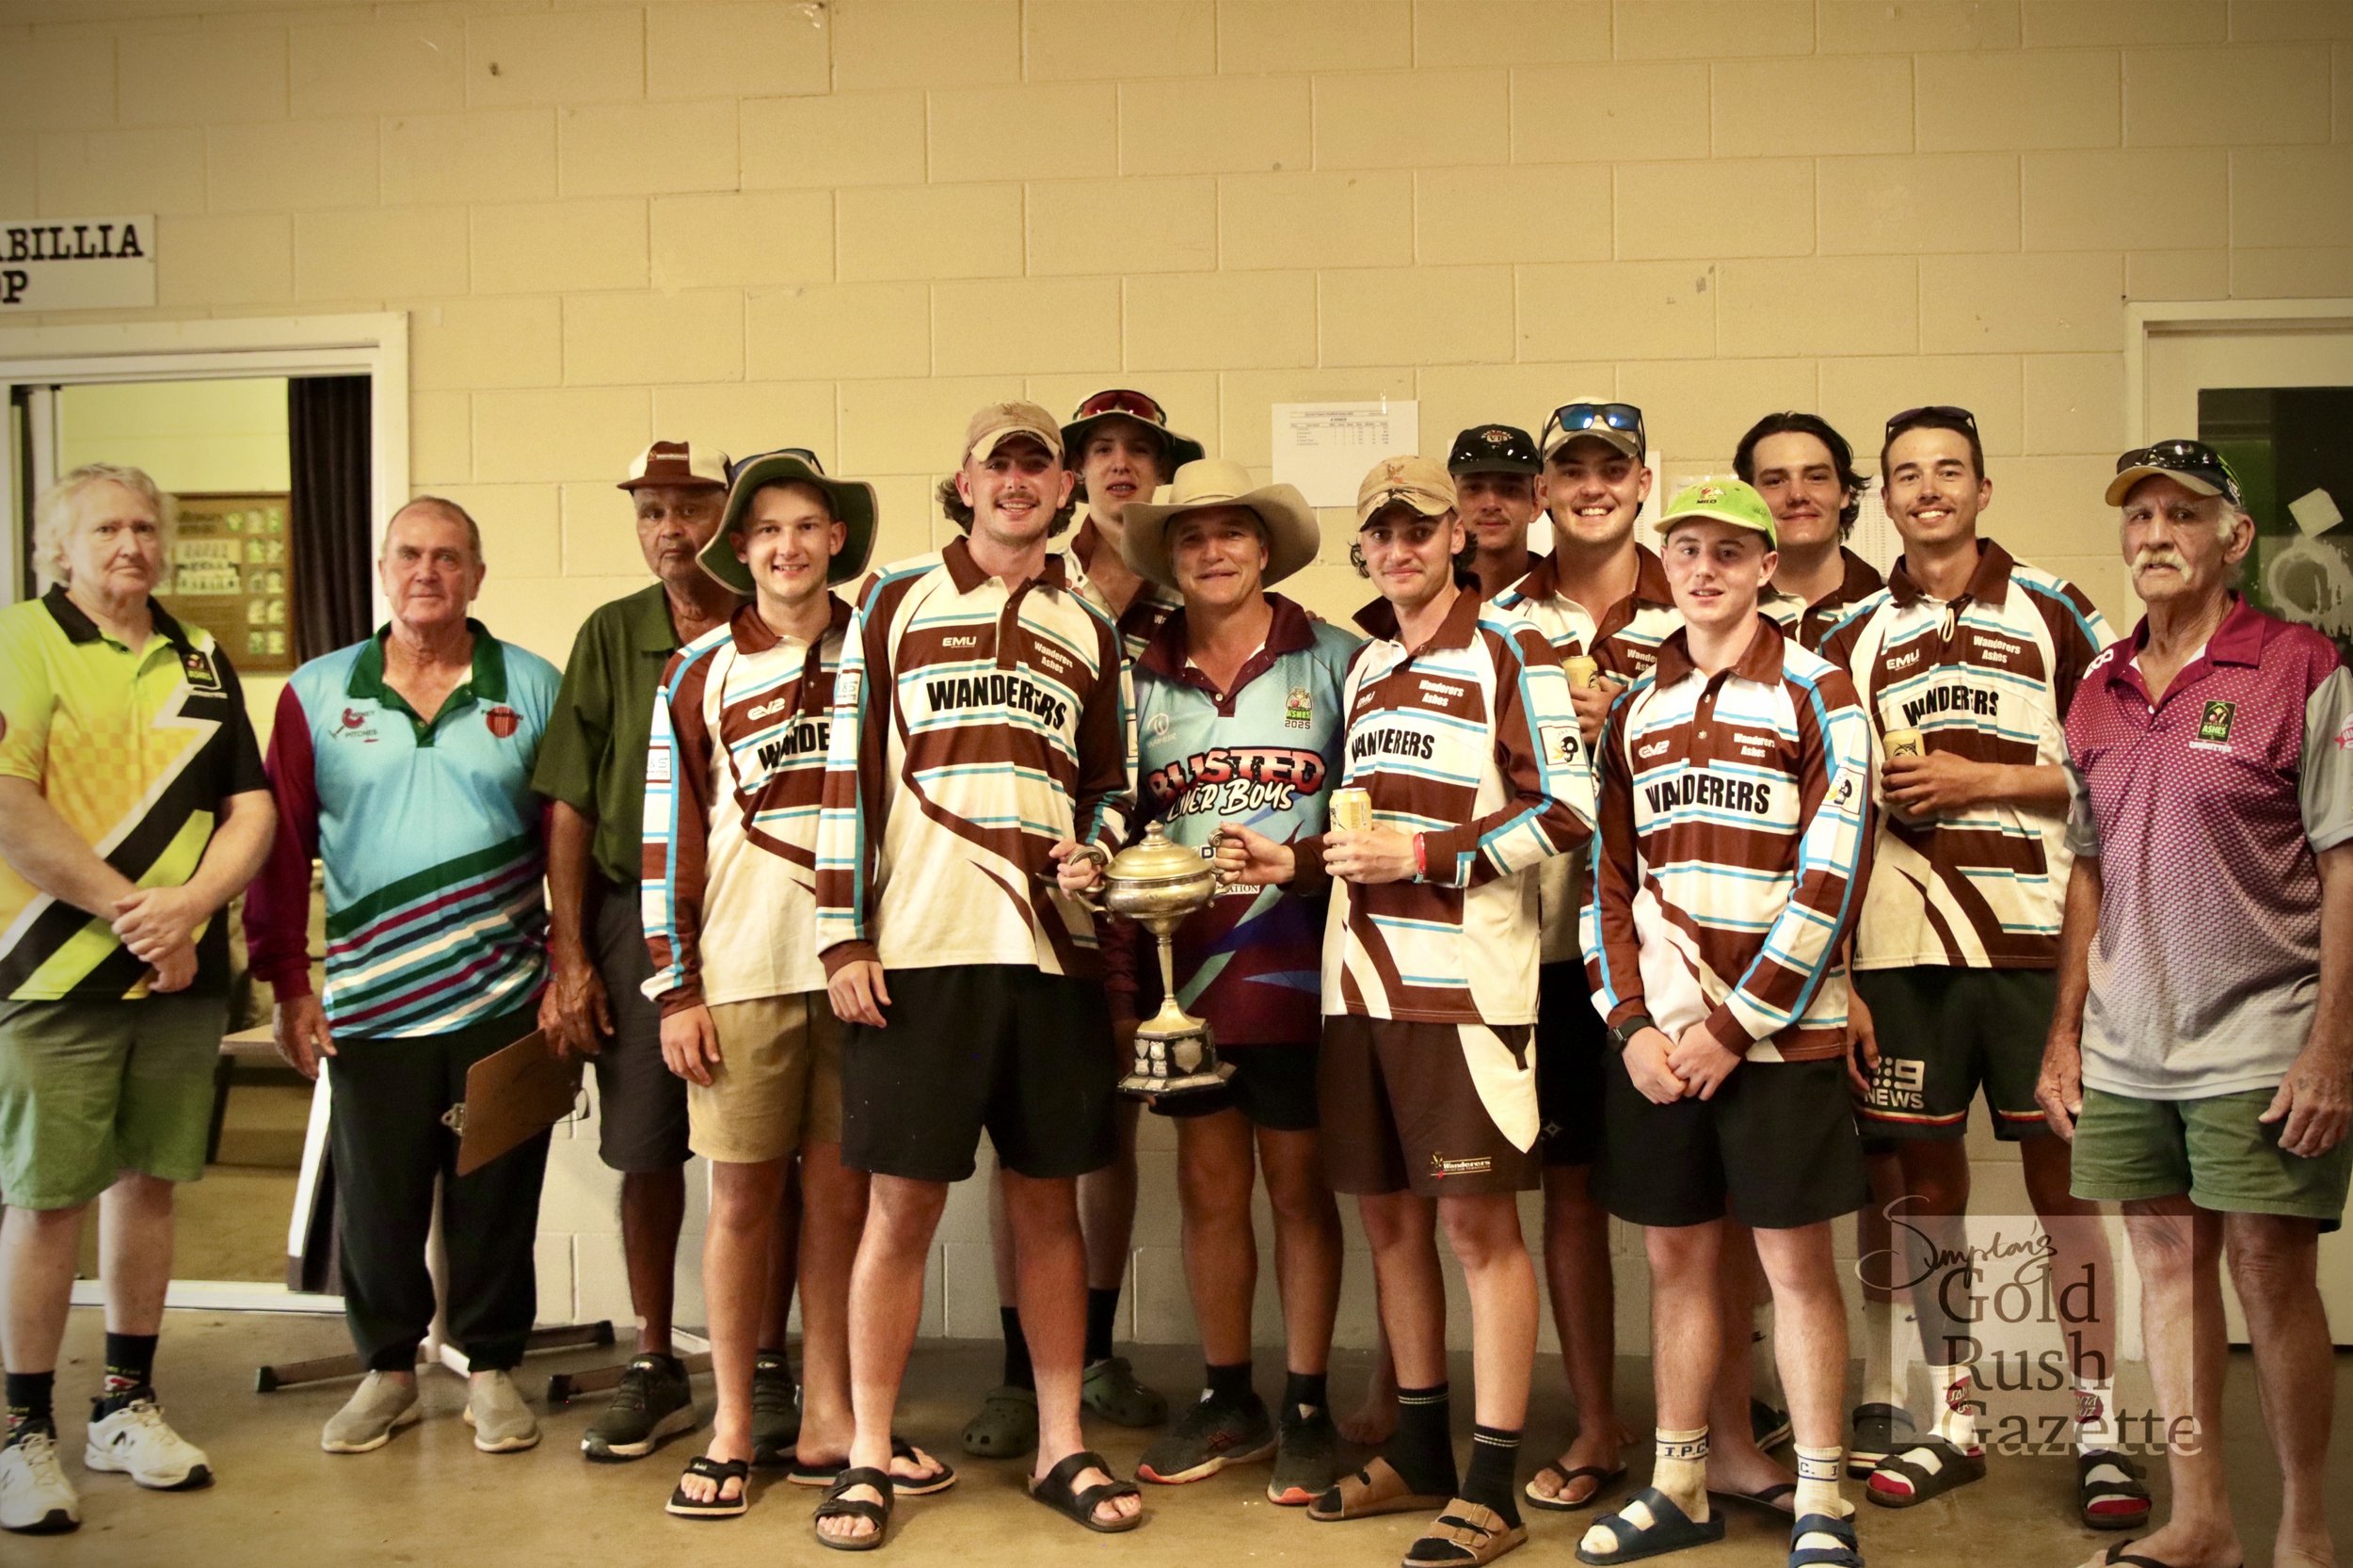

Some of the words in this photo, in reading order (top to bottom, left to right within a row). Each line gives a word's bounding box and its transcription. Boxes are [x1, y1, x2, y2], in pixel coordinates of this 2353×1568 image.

[0, 224, 144, 263] BILLIA
[0, 270, 28, 304] P
[942, 636, 977, 648] EMU
[1973, 635, 2021, 655] Wanderers
[1626, 648, 1657, 663] Wande
[1886, 648, 1920, 670] EMU
[1981, 649, 2008, 664] Ashes
[1041, 656, 1064, 675] Ashes
[1419, 680, 1465, 697] Wanderers
[926, 674, 1067, 731] WANDERERS
[1422, 693, 1449, 707] Ashes
[1287, 710, 1310, 719] ASHES
[1285, 720, 1310, 729] 2025
[2201, 725, 2227, 735] ASHES
[1740, 745, 1767, 759] Ashes
[1146, 746, 1327, 800] BUSTED
[1894, 1058, 1925, 1092] 9
[1865, 1088, 1925, 1110] NEWS
[1443, 1160, 1490, 1170] Wanderers
